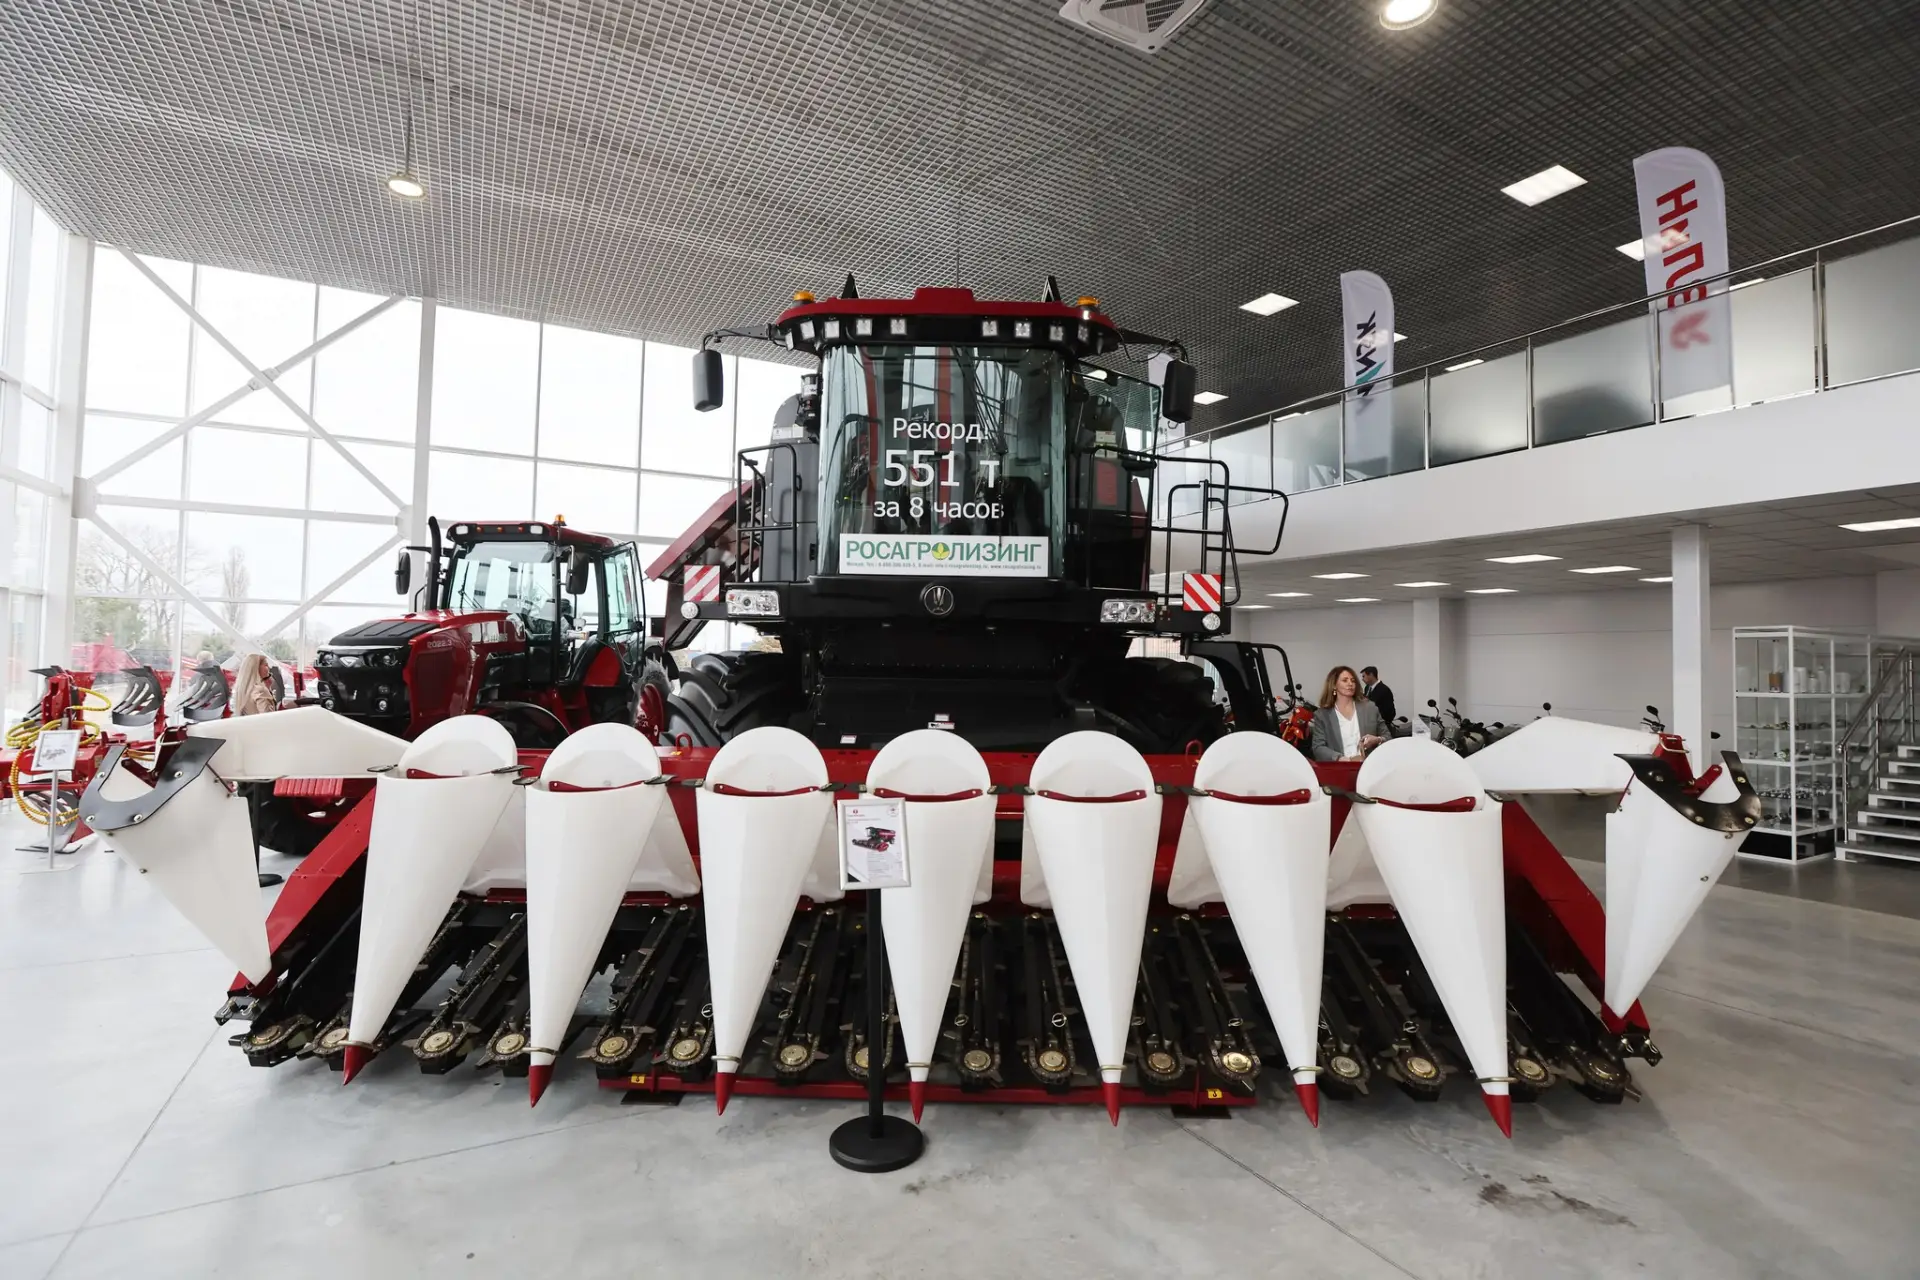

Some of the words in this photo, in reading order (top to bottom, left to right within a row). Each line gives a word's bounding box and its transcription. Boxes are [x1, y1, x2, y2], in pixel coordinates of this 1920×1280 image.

[893, 417, 989, 444] Рекорд!
[884, 449, 960, 487] 551
[873, 501, 900, 518] за
[909, 497, 924, 518] 8
[934, 501, 1005, 519] часов
[427, 639, 453, 649] 2022.3
